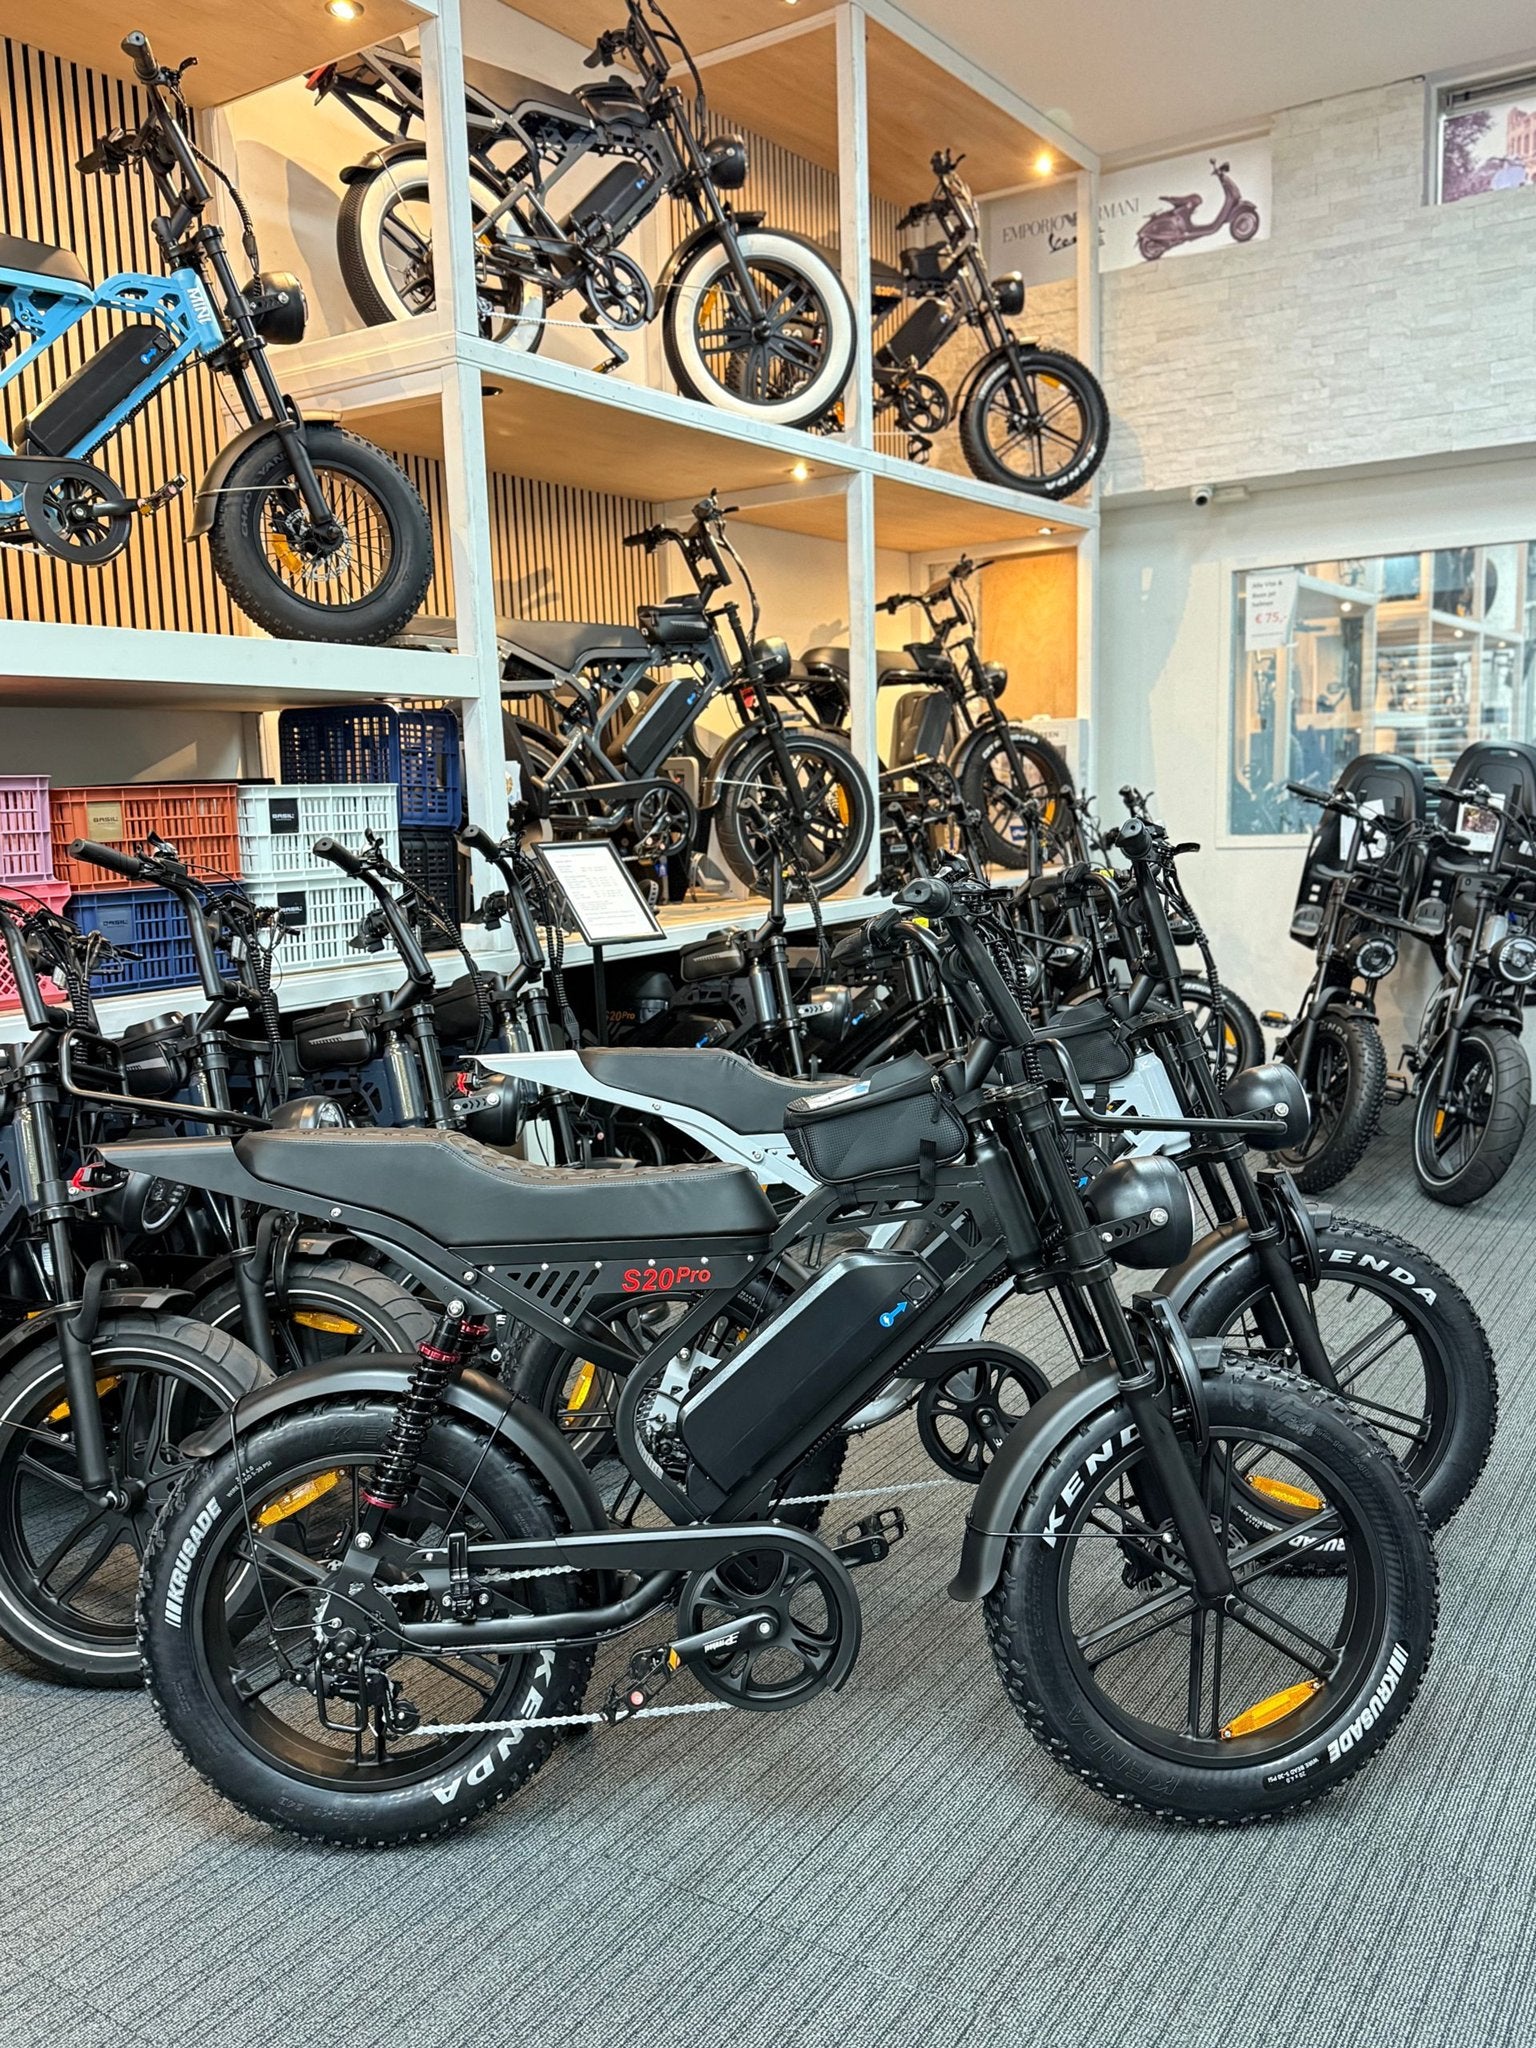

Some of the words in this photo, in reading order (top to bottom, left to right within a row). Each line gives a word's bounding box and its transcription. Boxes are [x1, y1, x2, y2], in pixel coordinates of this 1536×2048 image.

[1003, 214, 1065, 243] EMPORIO
[1099, 198, 1140, 219] MANI
[186, 288, 212, 324] MINI
[258, 452, 289, 478] YAN
[1045, 443, 1097, 490] KENDA
[1255, 614, 1262, 624] €
[1319, 1020, 1349, 1043] ENDA
[1319, 1249, 1437, 1307] ENDA
[226, 1484, 240, 1498] WIRE
[1042, 1423, 1142, 1549] KEND
[166, 1496, 223, 1604] KRUSADE
[432, 1649, 556, 1806] KENDA
[1327, 1667, 1401, 1764] KRUSADE
[1290, 1765, 1305, 1775] BEAD
[1304, 1757, 1320, 1769] WIRE
